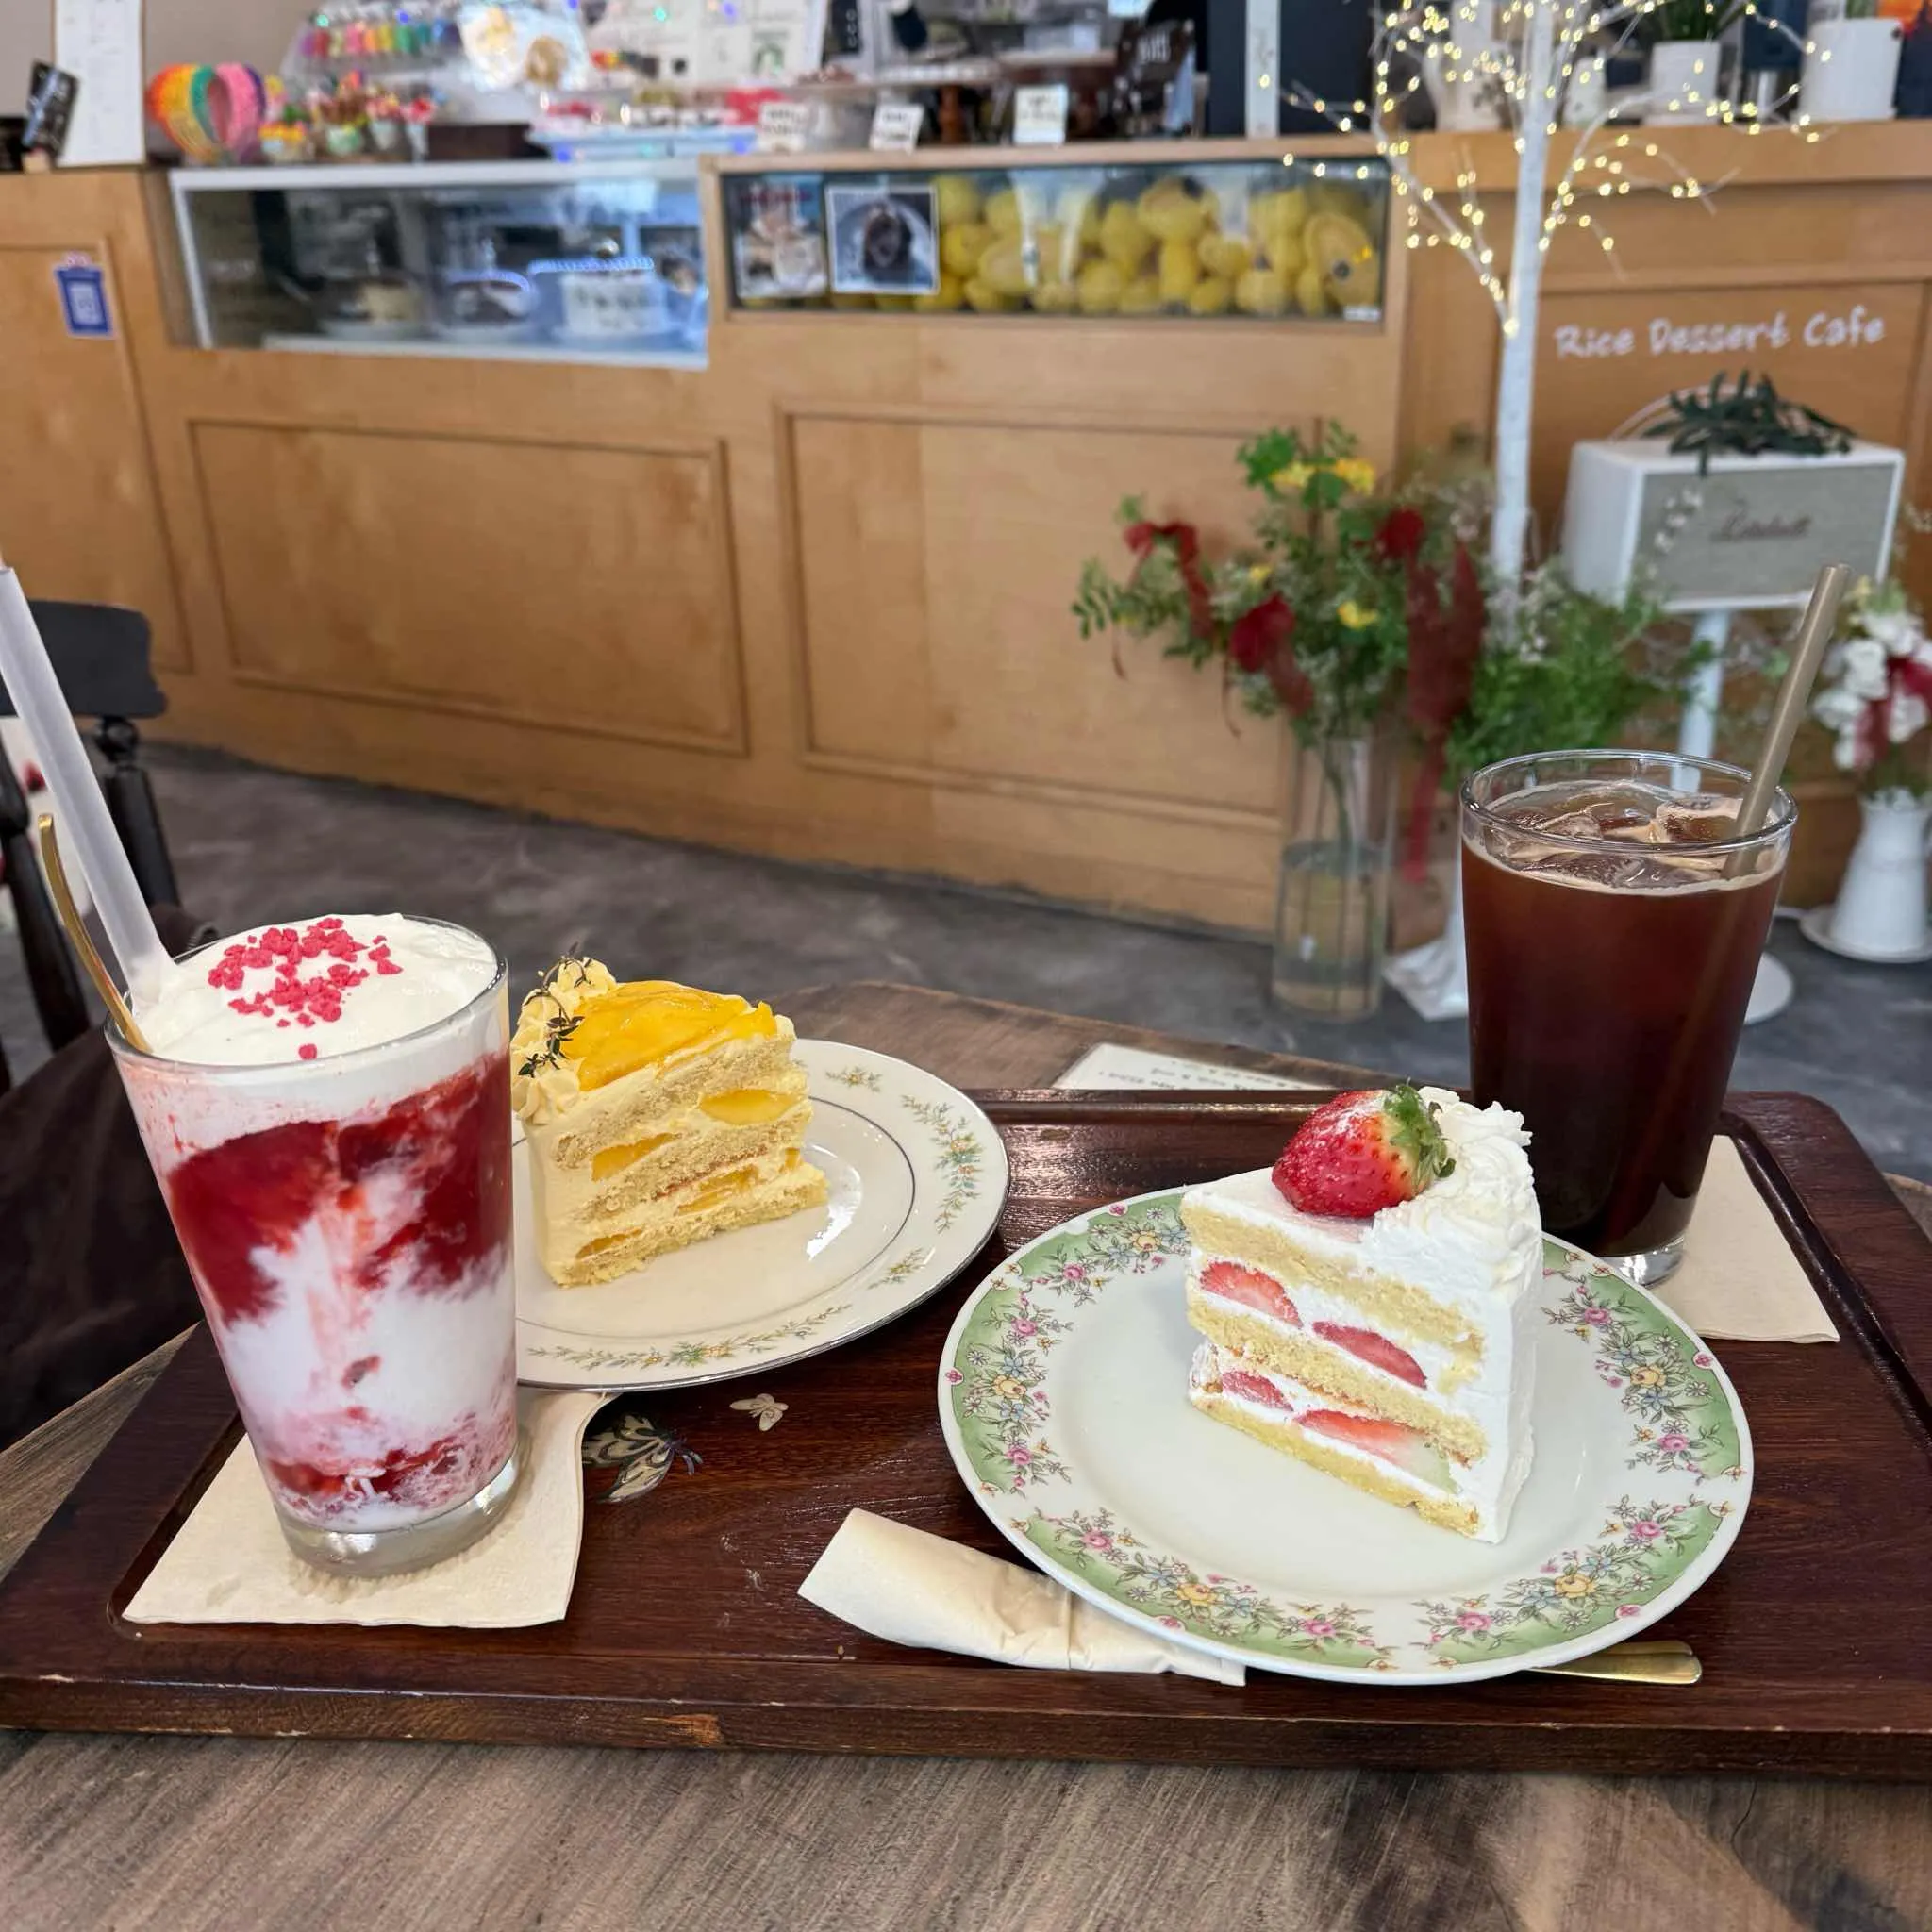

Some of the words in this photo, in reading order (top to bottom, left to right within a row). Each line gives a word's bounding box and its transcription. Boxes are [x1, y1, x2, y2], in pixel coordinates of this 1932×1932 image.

[1556, 324, 1635, 358] Rice
[1649, 311, 1790, 355] Dessert
[1803, 304, 1884, 347] Cafe
